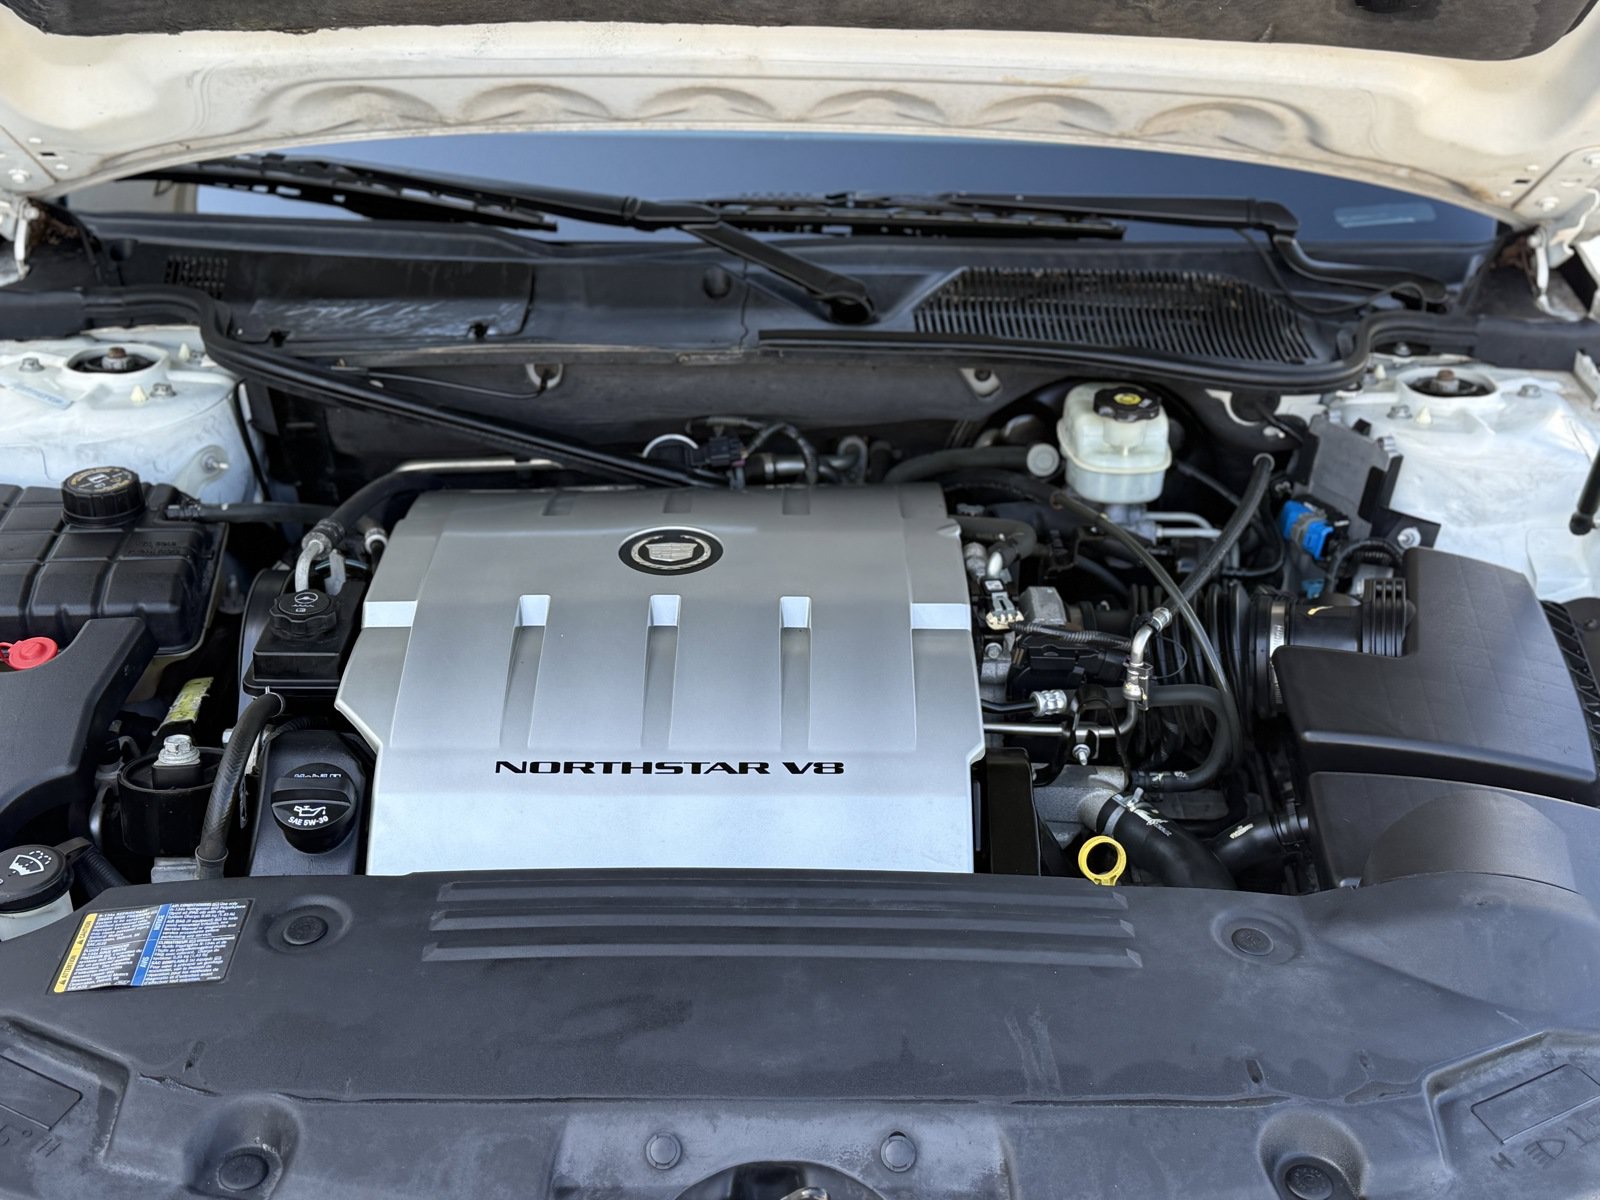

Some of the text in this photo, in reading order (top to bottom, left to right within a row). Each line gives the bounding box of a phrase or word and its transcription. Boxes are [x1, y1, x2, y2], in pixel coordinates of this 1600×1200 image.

[494, 760, 845, 775] NORTHSTAR V8
[288, 815, 329, 827] SAE 5W-30
[78, 920, 92, 940] CAUTION
[62, 955, 77, 979] ATTENTION
